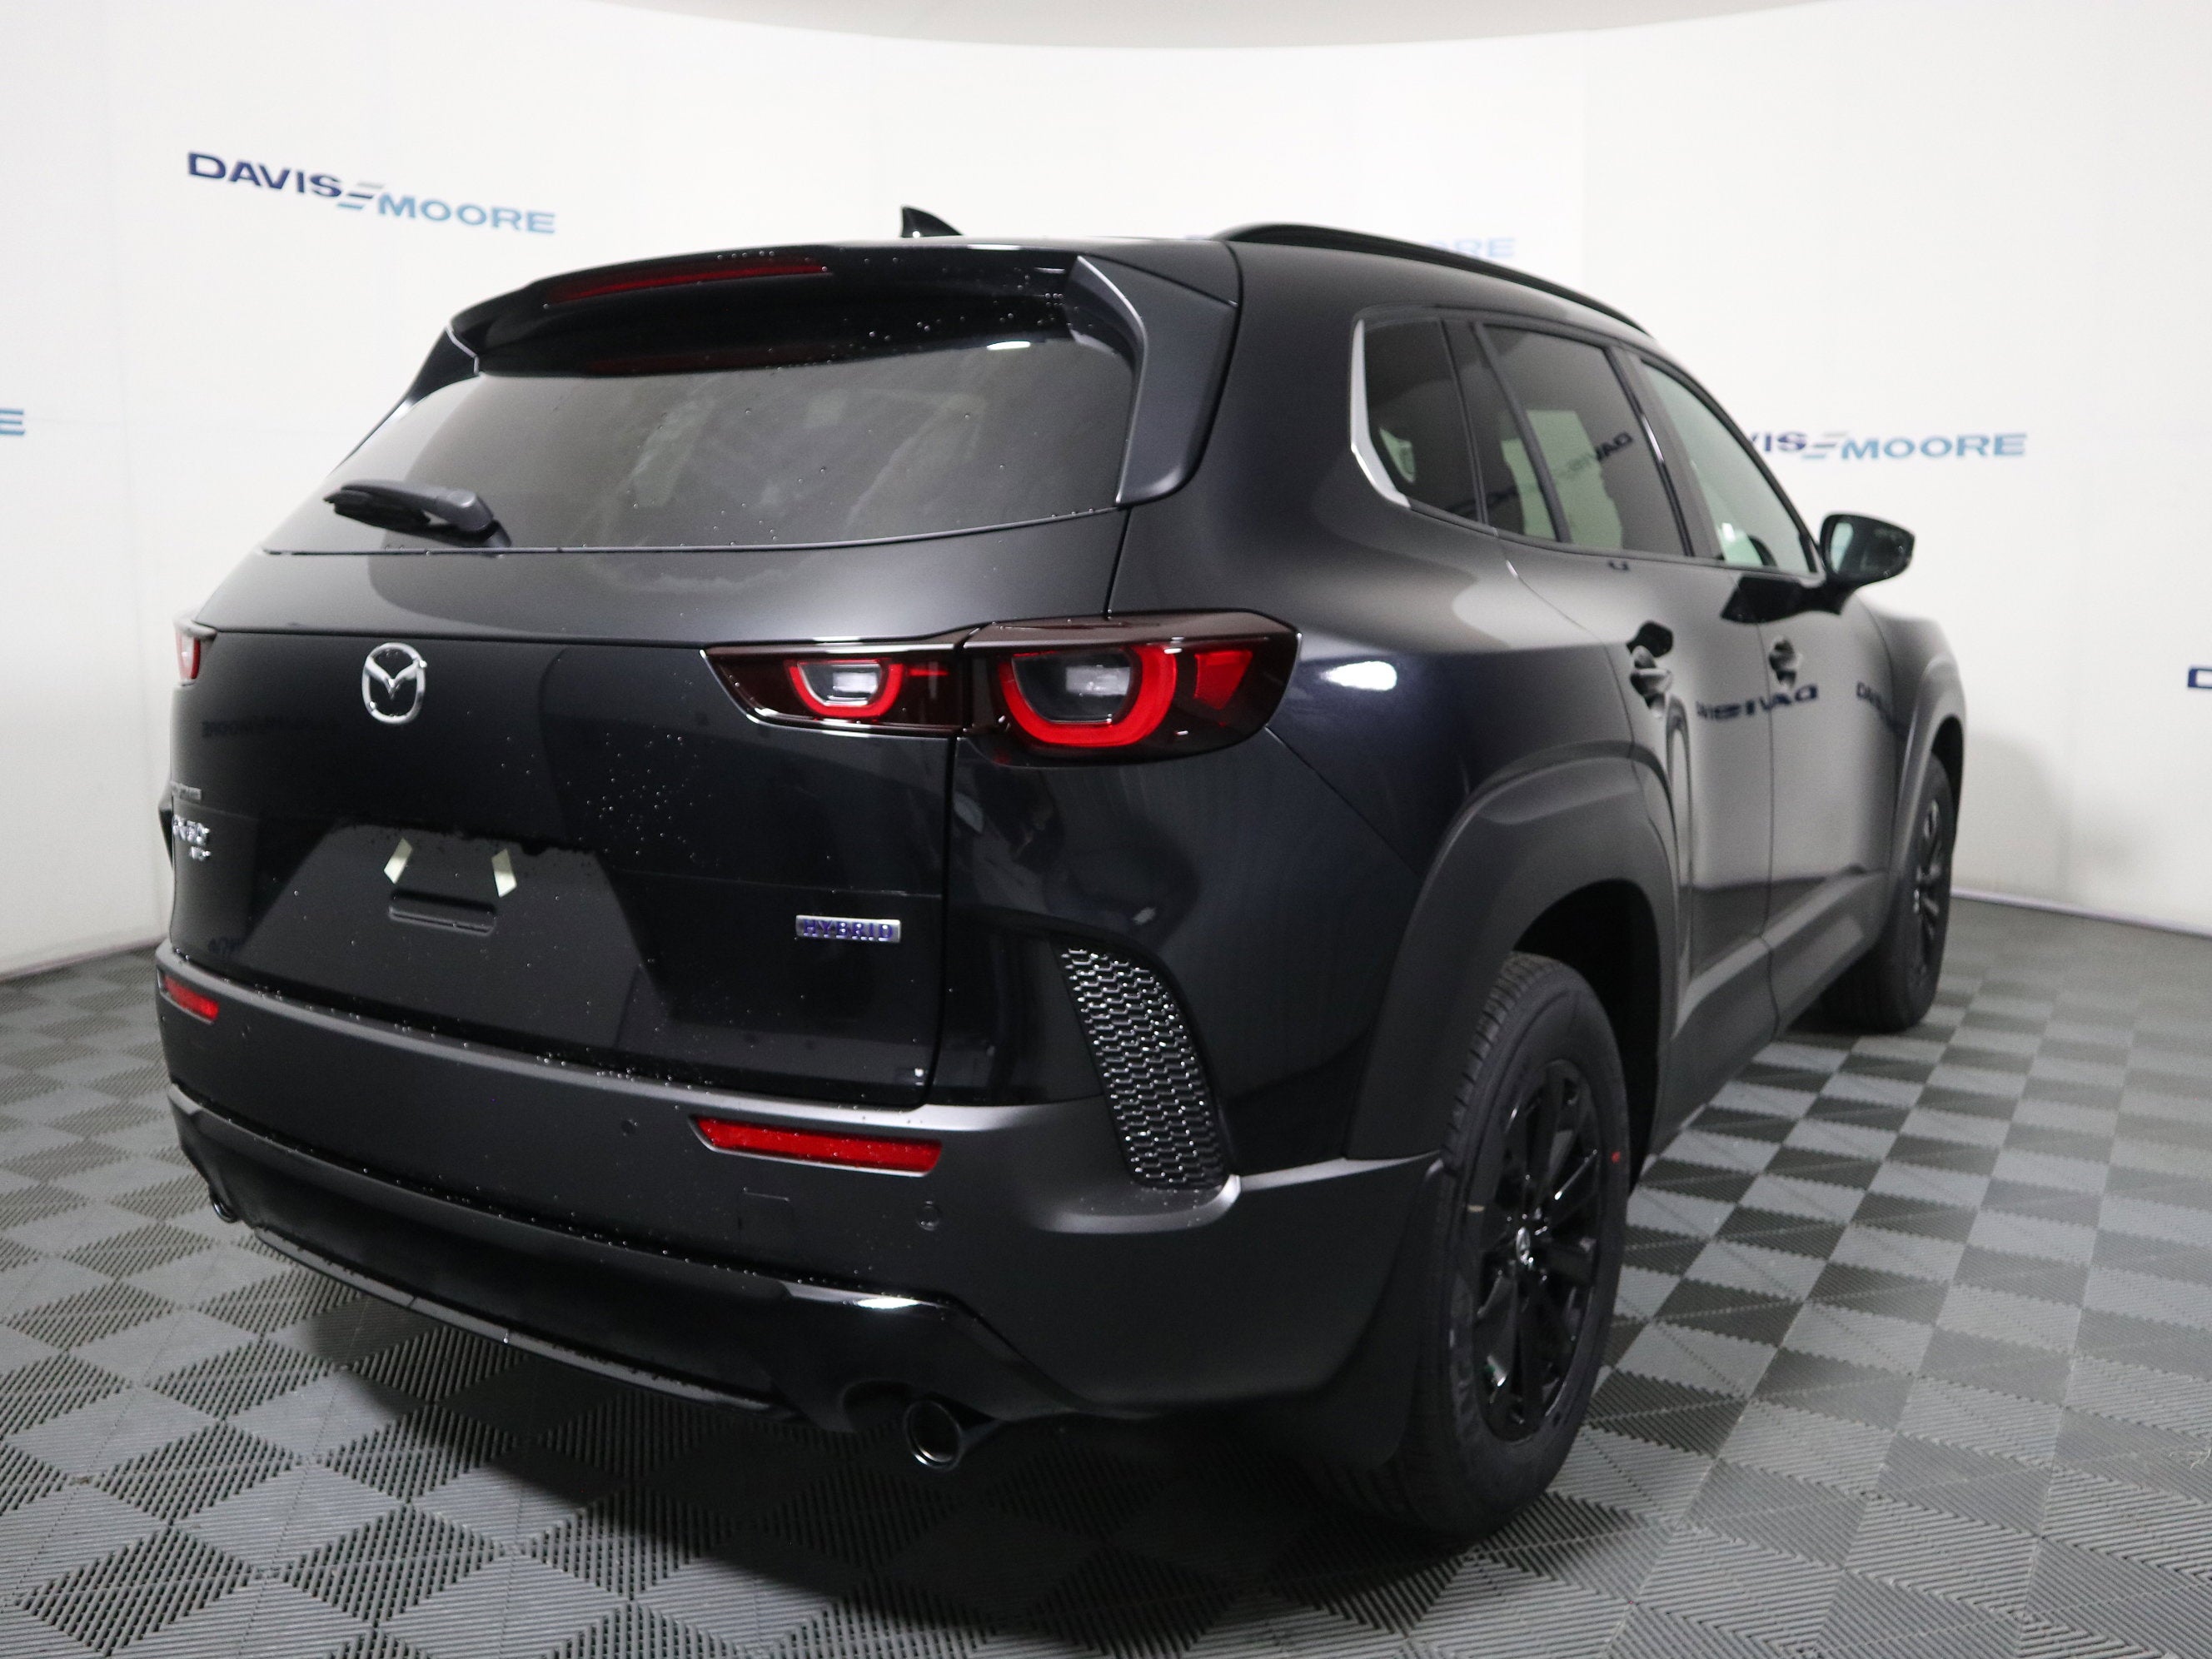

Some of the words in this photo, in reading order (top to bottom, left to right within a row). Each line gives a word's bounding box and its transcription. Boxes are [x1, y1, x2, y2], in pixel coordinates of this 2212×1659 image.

[187, 151, 342, 197] DAVIS
[377, 192, 556, 235] MOORE
[1841, 433, 2026, 460] MOORE
[803, 919, 894, 942] HYBRID
